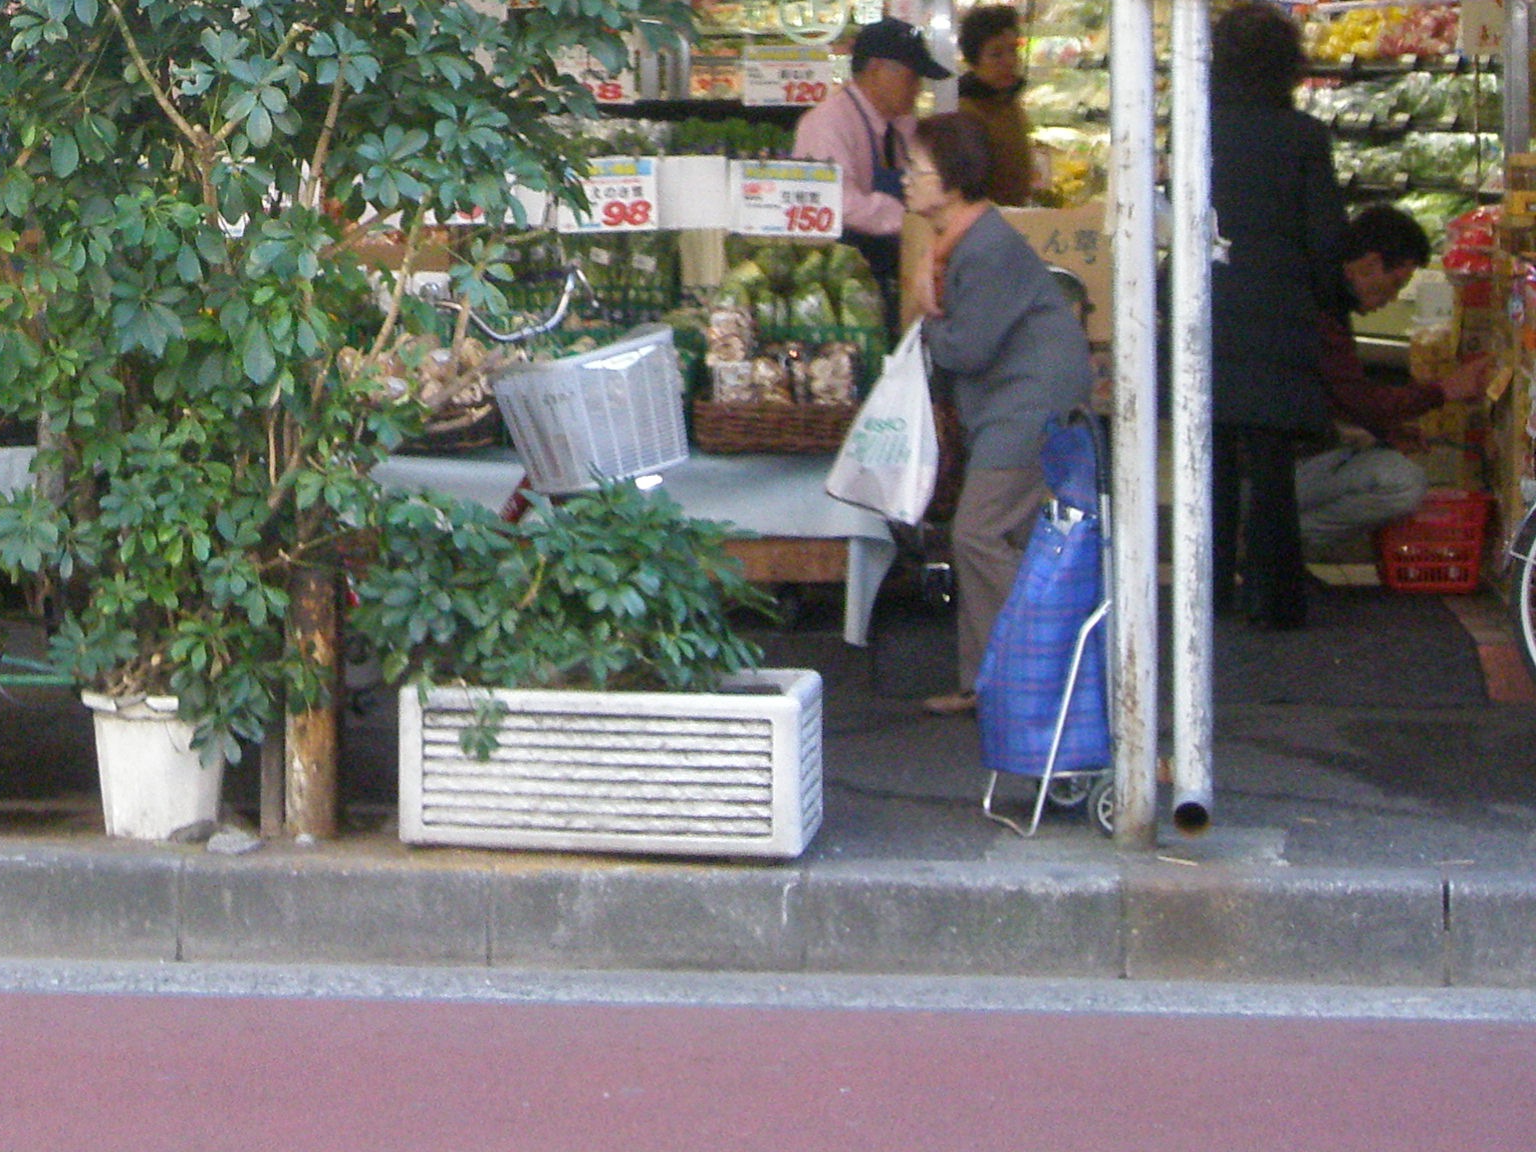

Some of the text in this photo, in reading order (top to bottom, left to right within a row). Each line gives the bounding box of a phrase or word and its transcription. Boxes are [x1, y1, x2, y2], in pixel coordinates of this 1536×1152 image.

[782, 81, 828, 103] 120
[602, 199, 652, 226] 98
[783, 204, 835, 232] 150
